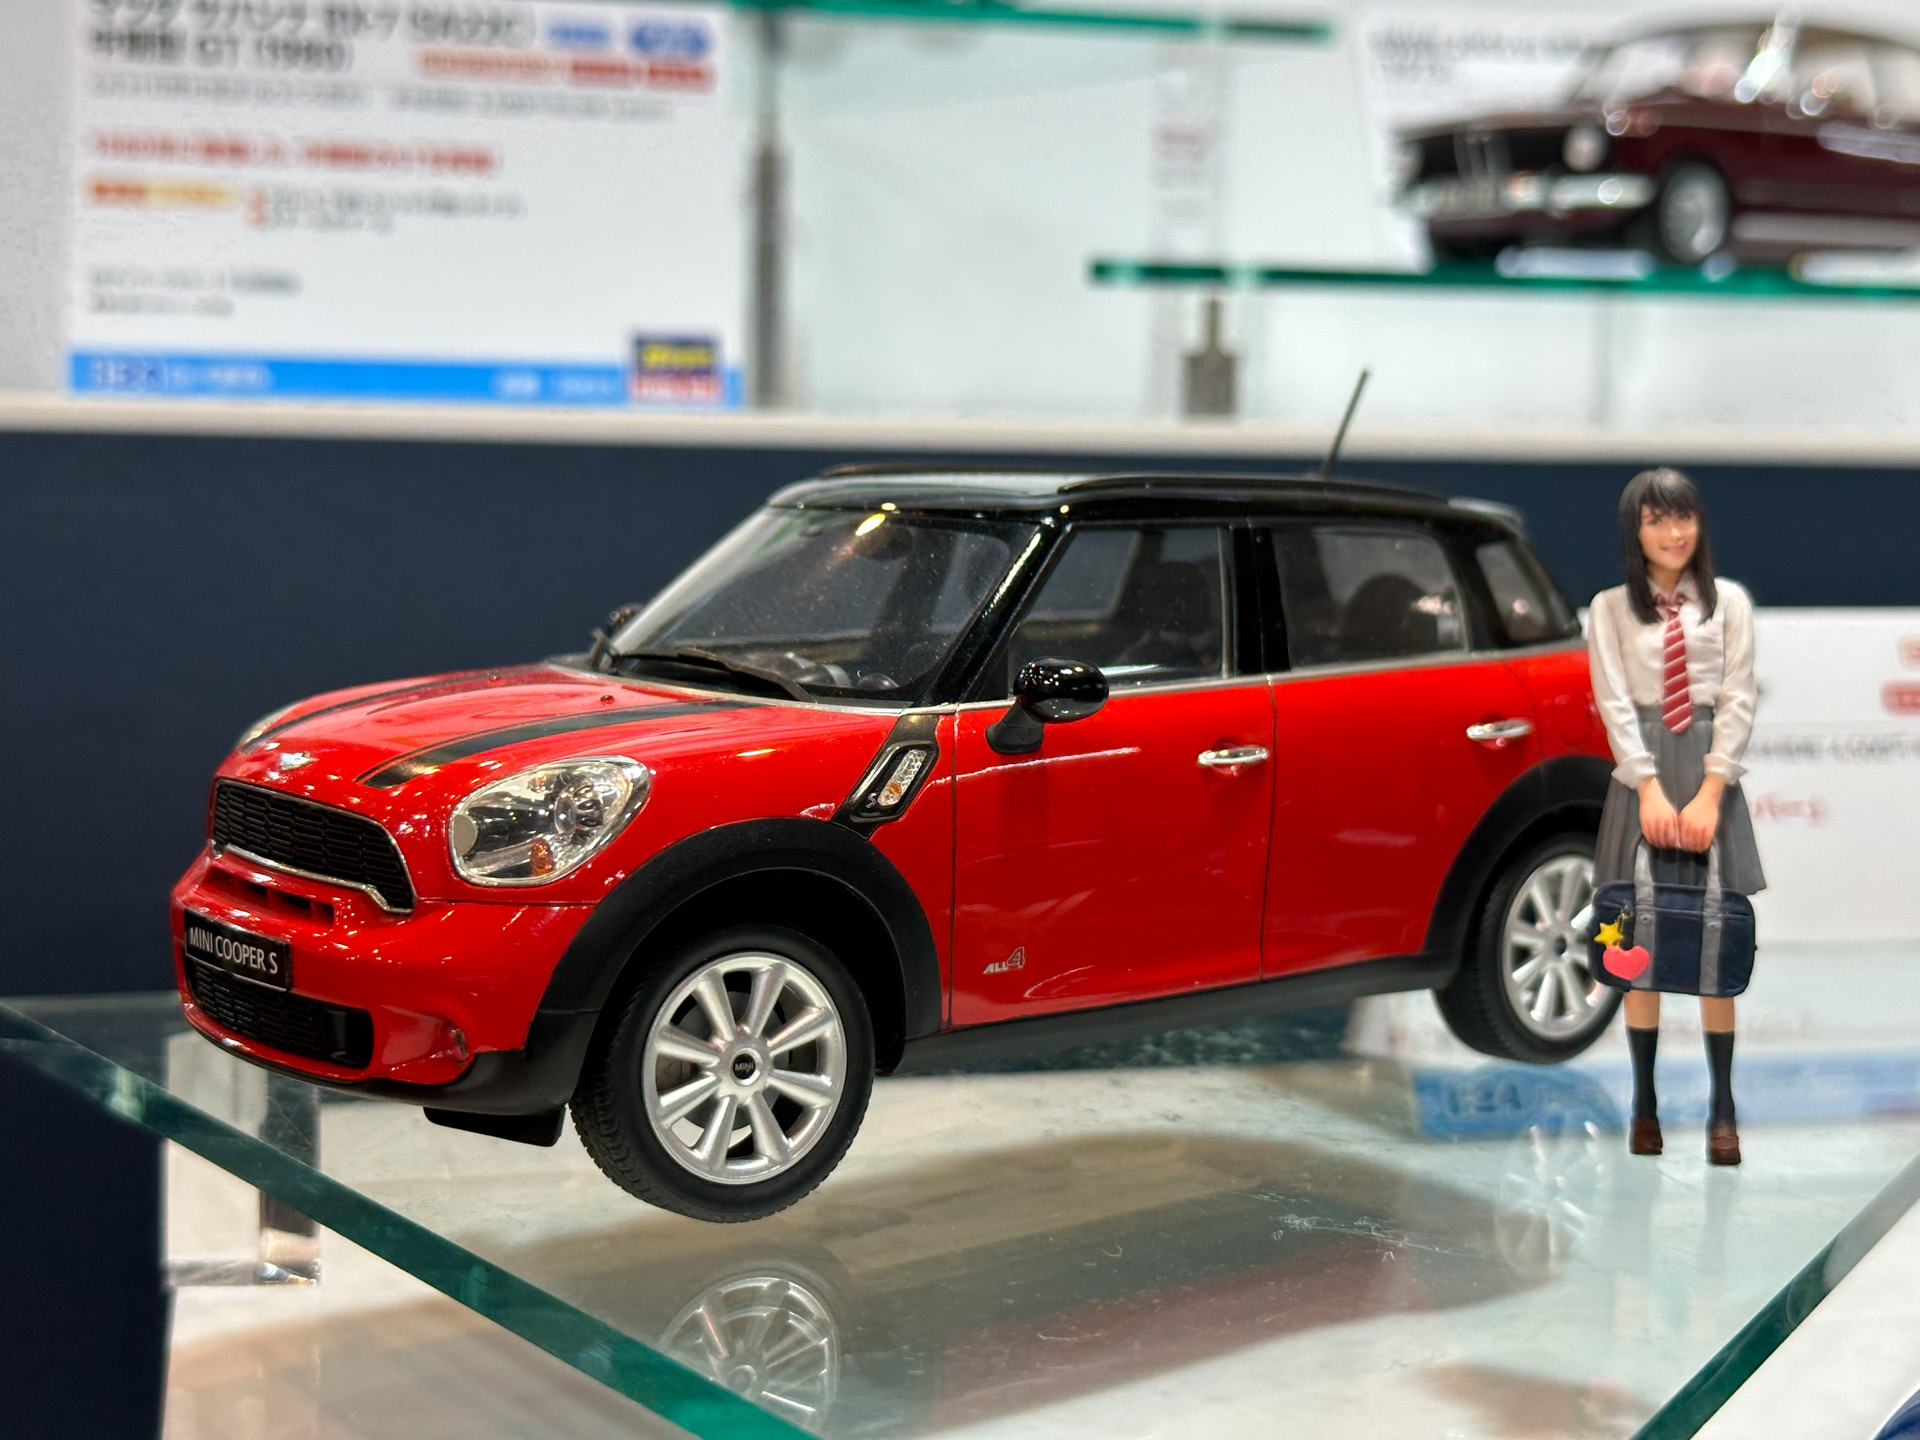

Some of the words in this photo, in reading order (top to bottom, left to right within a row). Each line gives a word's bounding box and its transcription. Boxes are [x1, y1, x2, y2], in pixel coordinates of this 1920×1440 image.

[190, 926, 213, 954] MINI
[215, 935, 267, 972] COOPER
[269, 951, 279, 975] S
